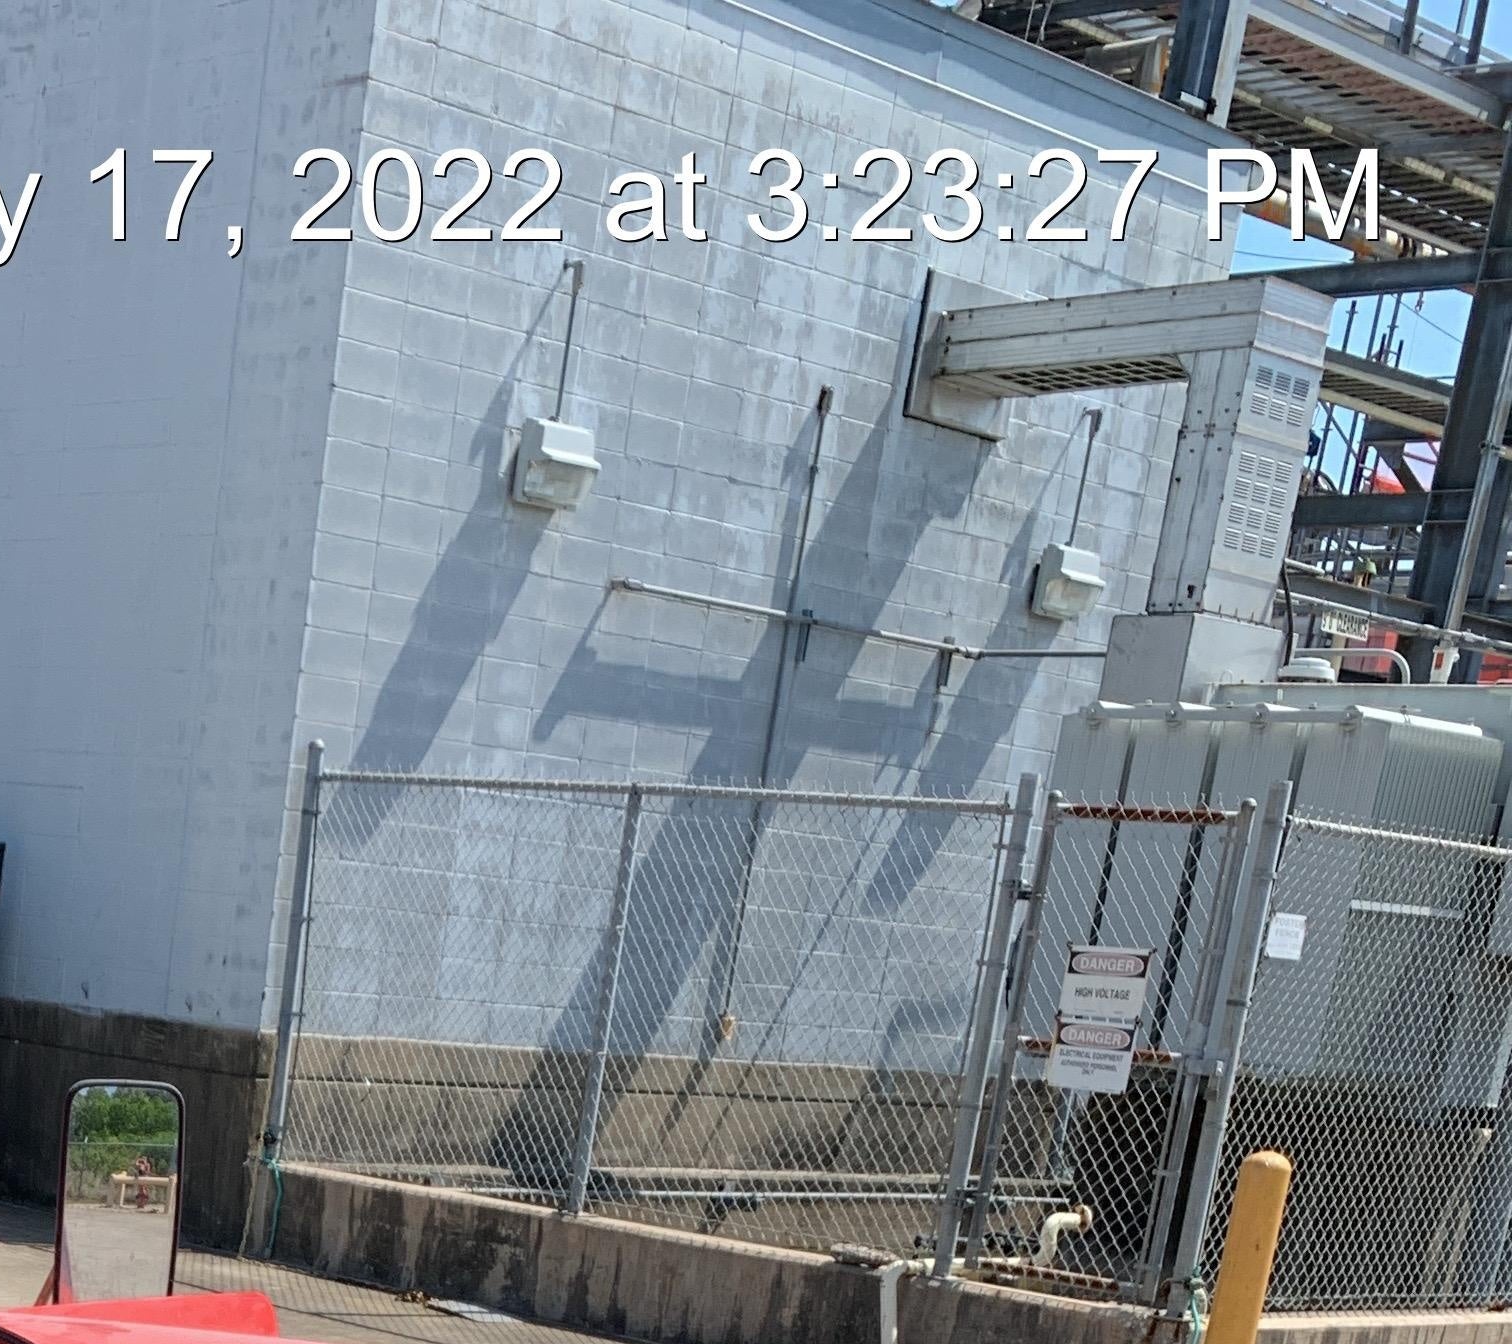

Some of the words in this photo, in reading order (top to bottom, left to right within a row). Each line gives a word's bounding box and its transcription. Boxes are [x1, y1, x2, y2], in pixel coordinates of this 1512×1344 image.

[1080, 955, 1135, 972] DANGER
[1075, 986, 1093, 998] HIGH
[1094, 988, 1130, 1000] VOLTAGE
[1068, 1029, 1122, 1046] DANGER
